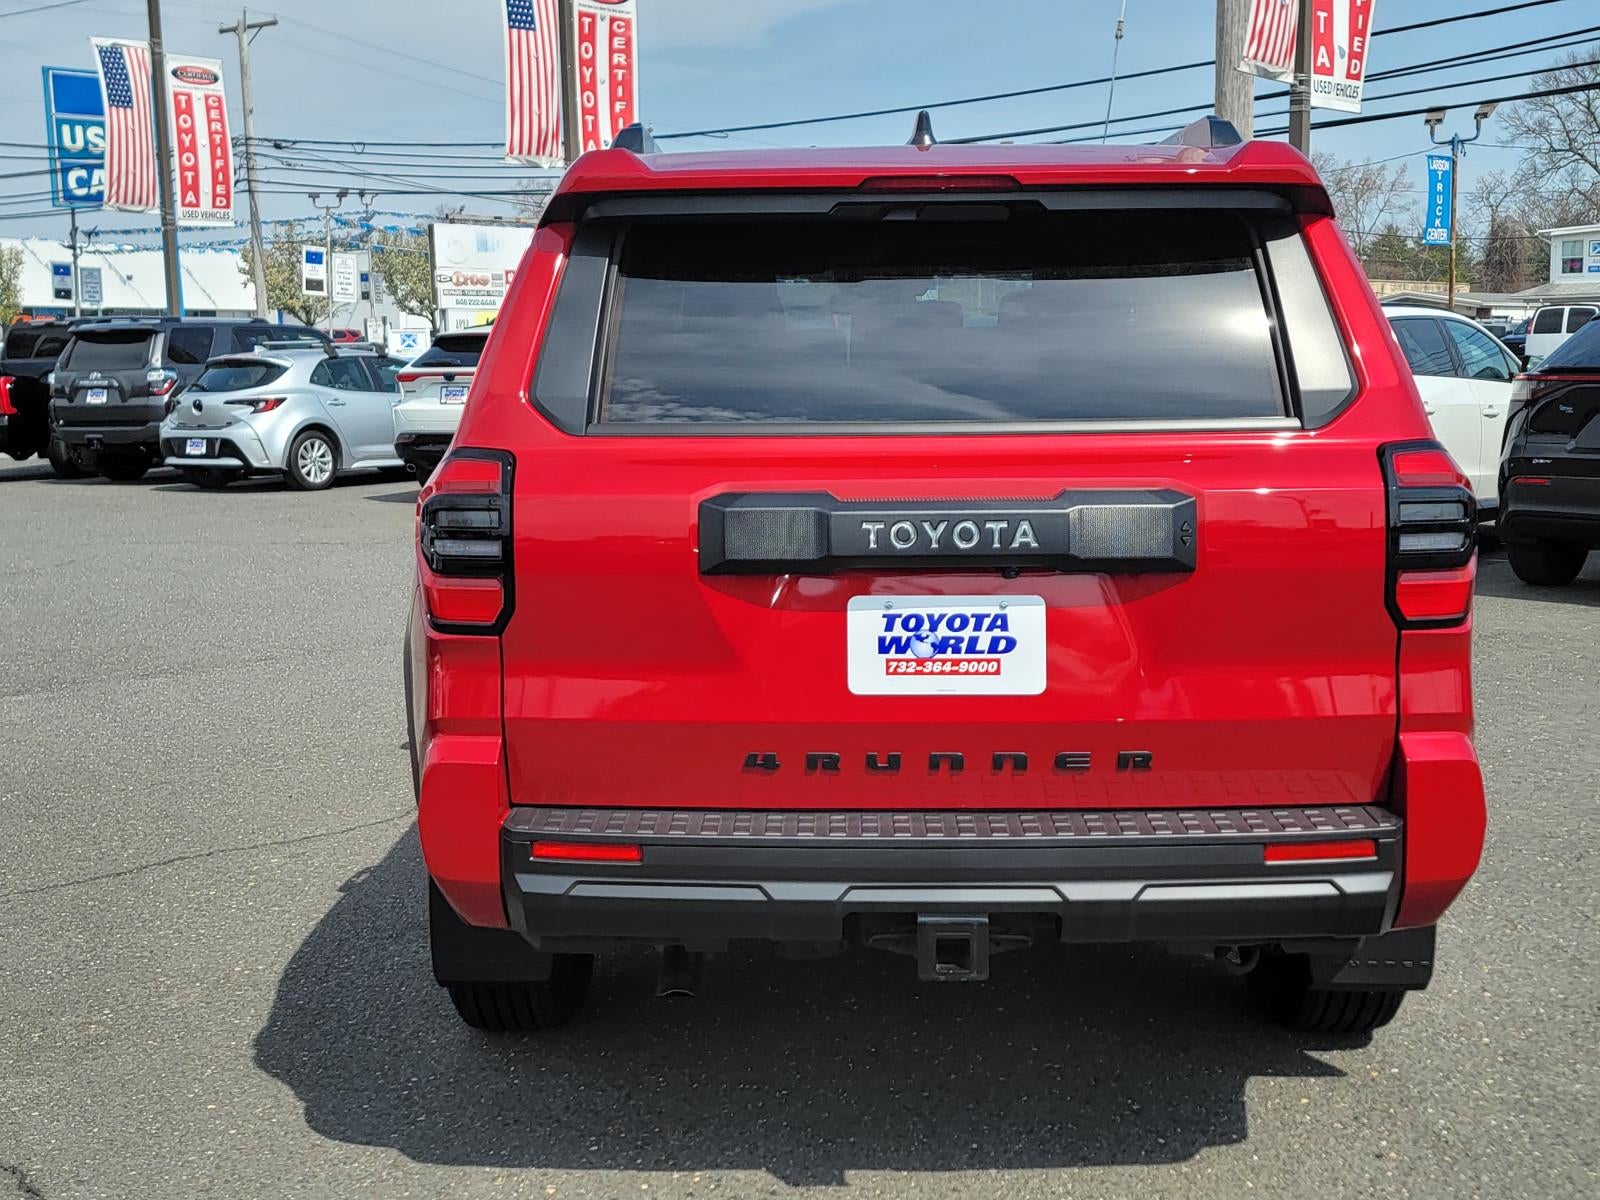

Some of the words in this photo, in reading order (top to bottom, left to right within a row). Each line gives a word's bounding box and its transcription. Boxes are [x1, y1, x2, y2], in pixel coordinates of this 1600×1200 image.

[581, 16, 597, 152] TOYOTA
[1313, 79, 1333, 95] USED
[178, 94, 197, 205] TOYOTA
[208, 96, 227, 206] CERTIFIED
[1429, 158, 1450, 172] LARSON
[1434, 171, 1444, 228] TRUCK
[182, 210, 200, 218] USED
[200, 210, 231, 220] VEHICLES
[1426, 228, 1448, 241] CENTER
[861, 520, 1040, 549] TOYOTA
[881, 613, 1009, 632] TOYOTA
[877, 635, 1018, 657] WORLD
[888, 661, 998, 673] 732-364-9000
[742, 751, 1154, 773] 4RUNNER
